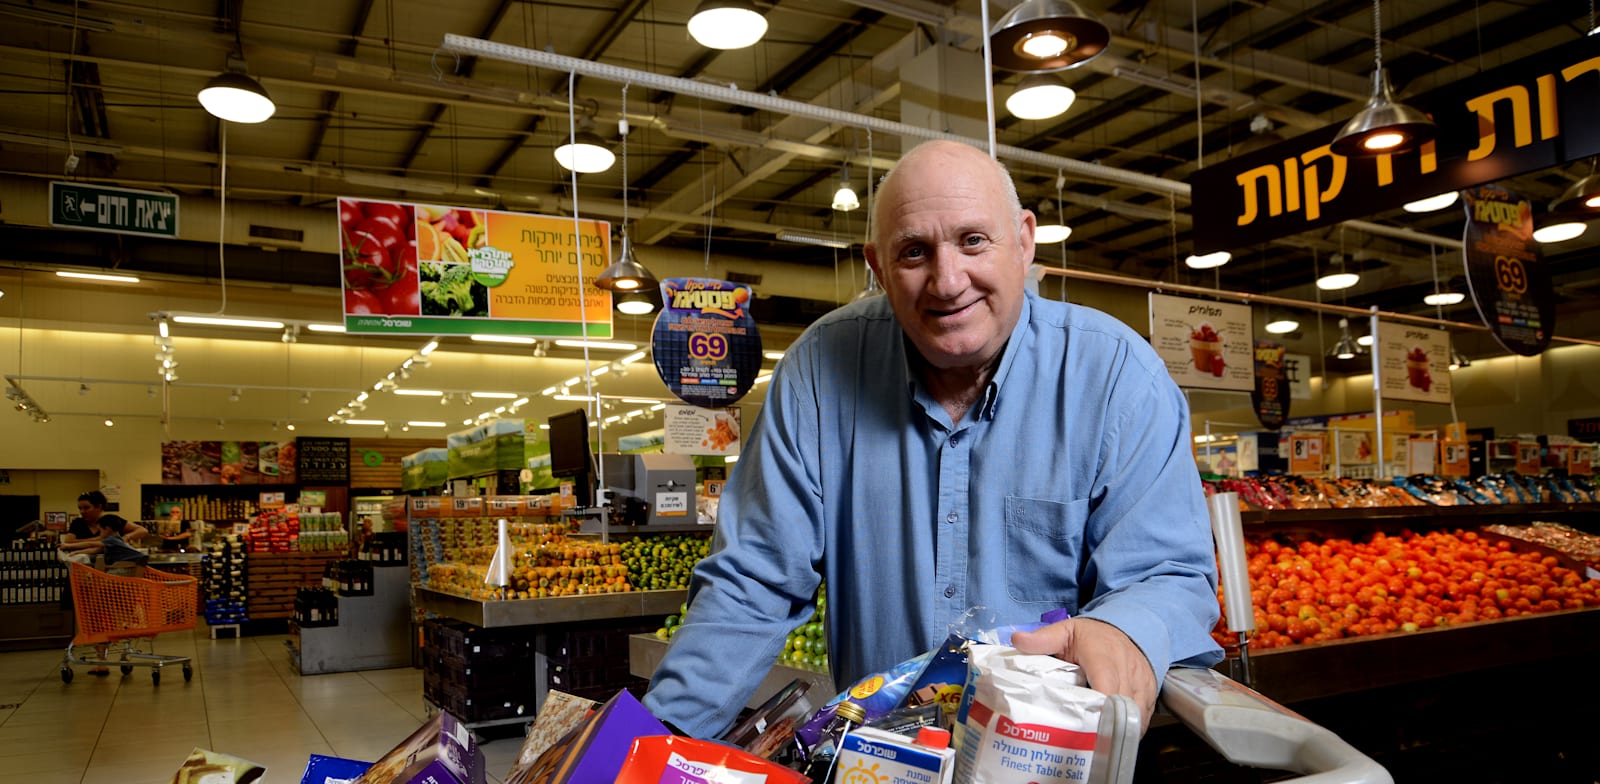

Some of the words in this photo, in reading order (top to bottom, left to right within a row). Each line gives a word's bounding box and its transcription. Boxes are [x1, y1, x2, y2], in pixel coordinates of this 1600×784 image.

[98, 195, 129, 225] חרום
[135, 198, 171, 230] יציאת
[521, 229, 563, 249] וירקות
[535, 249, 562, 263] יותר
[568, 251, 603, 267] טרים
[546, 273, 580, 285] מבצעים
[1496, 256, 1527, 295] 69
[525, 284, 548, 294] בשנה
[551, 286, 578, 297] בדיקות
[495, 294, 526, 305] הדברה
[690, 333, 727, 360] 69
[1003, 722, 1050, 742] שופרסל
[856, 740, 897, 760] שופרסל
[992, 740, 1027, 757] מעולה
[1030, 749, 1062, 764] שולחן
[1000, 755, 1032, 774] Finest
[1035, 763, 1063, 778] Table
[1065, 769, 1084, 781] Salt
[1066, 755, 1086, 768] מלח
[906, 769, 932, 783] שמנת
